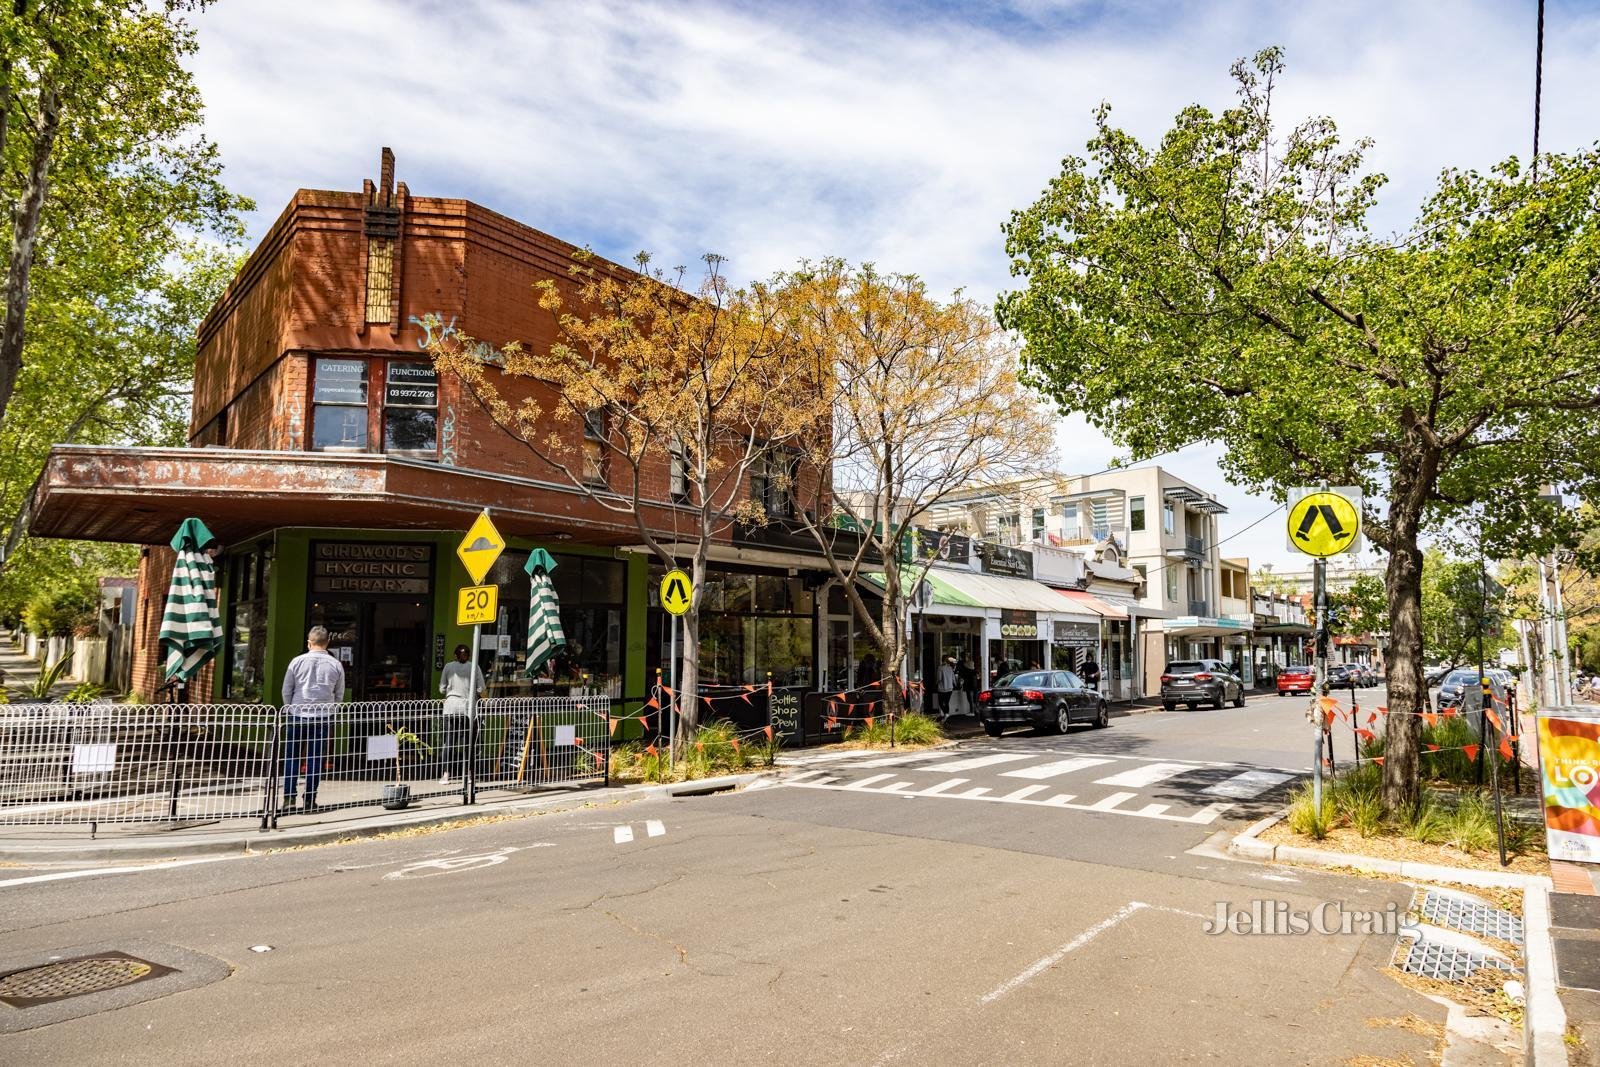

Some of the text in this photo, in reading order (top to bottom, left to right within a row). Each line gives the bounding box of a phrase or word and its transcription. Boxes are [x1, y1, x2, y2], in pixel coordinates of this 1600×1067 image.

[321, 363, 364, 373] CATERING
[391, 367, 435, 377] FUNCTIONS
[390, 388, 435, 398] 03 9372 2726
[325, 561, 416, 576] HYGIENIC
[465, 590, 489, 611] 20
[466, 611, 485, 621] km/h
[770, 694, 798, 706] Bottle
[770, 706, 798, 718] Shop
